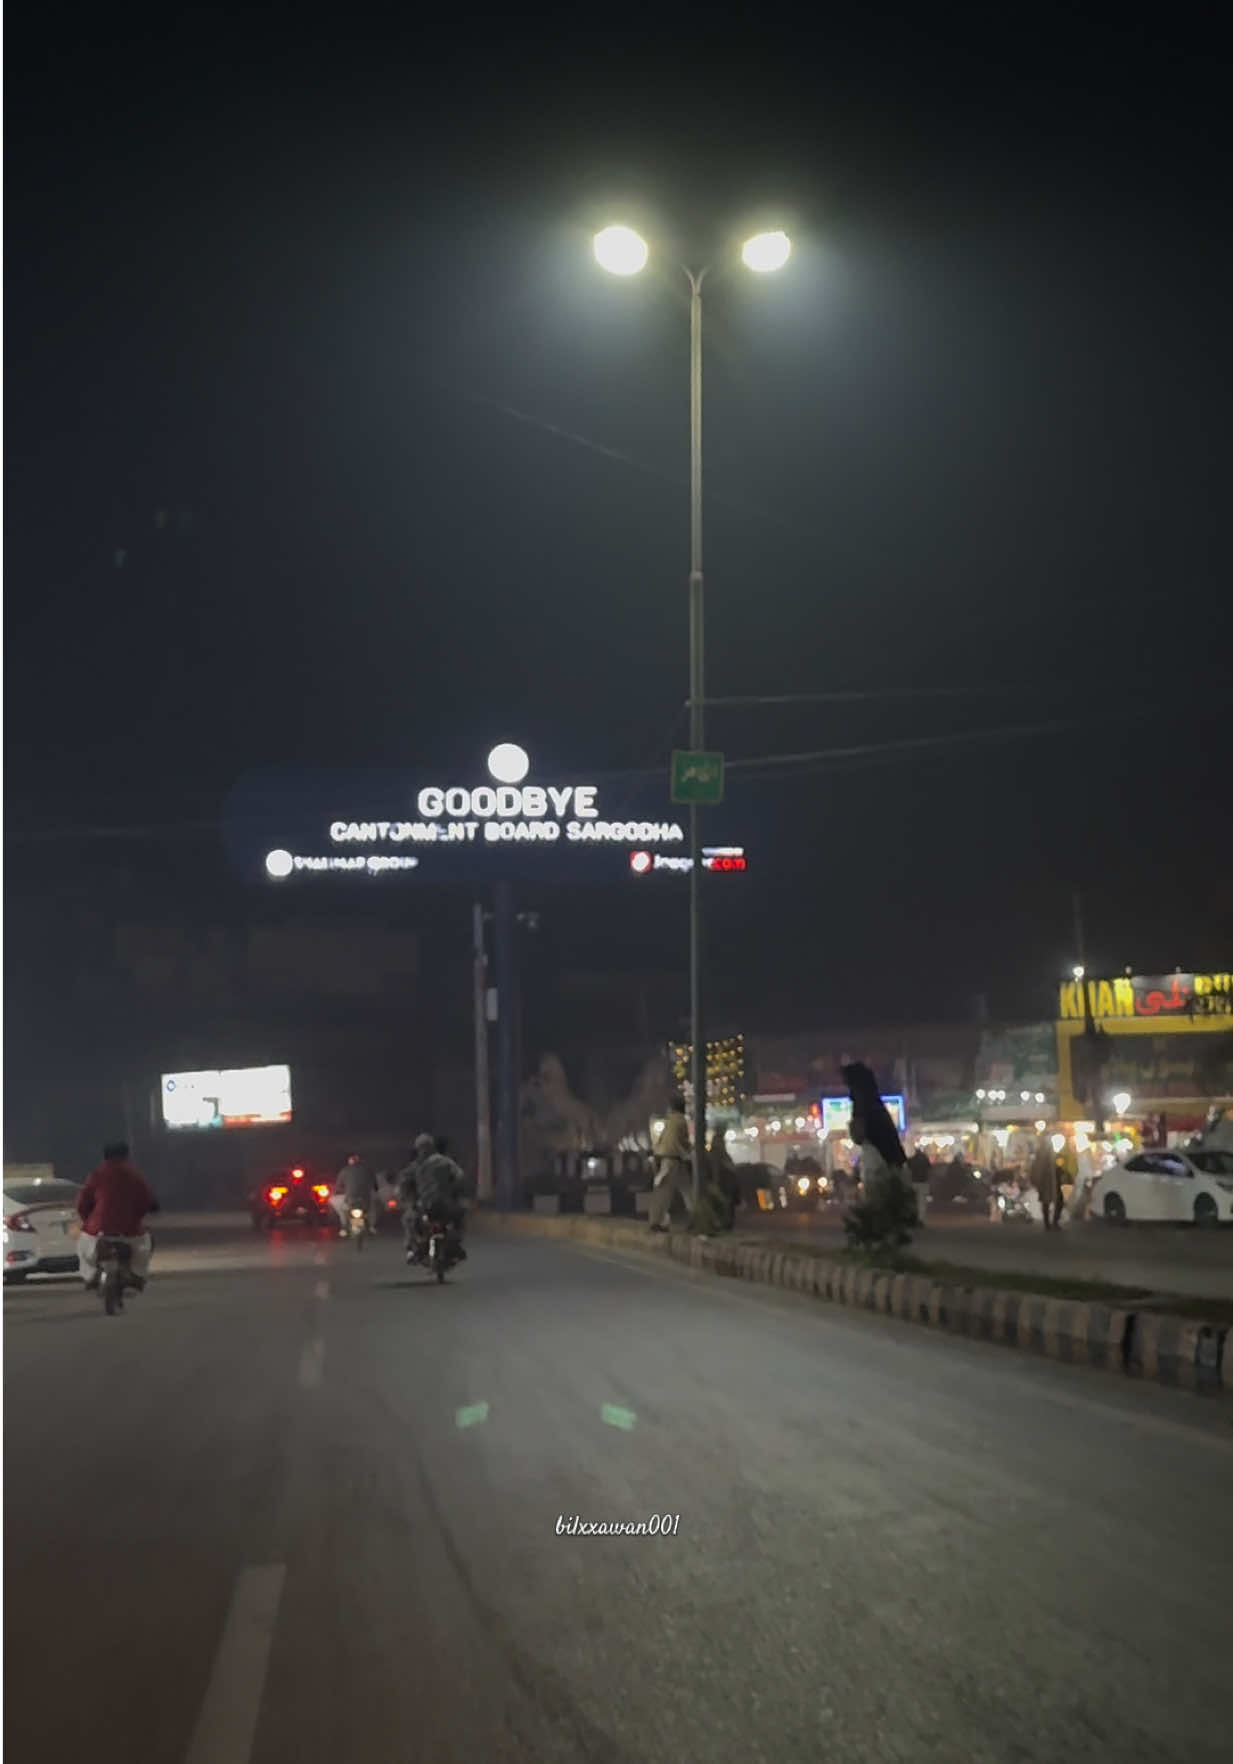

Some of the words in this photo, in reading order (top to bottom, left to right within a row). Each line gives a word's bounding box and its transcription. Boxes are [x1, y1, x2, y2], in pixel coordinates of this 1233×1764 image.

[418, 787, 598, 817] GOODBYE
[485, 822, 559, 841] BOARD
[567, 822, 683, 841] SARGODHA
